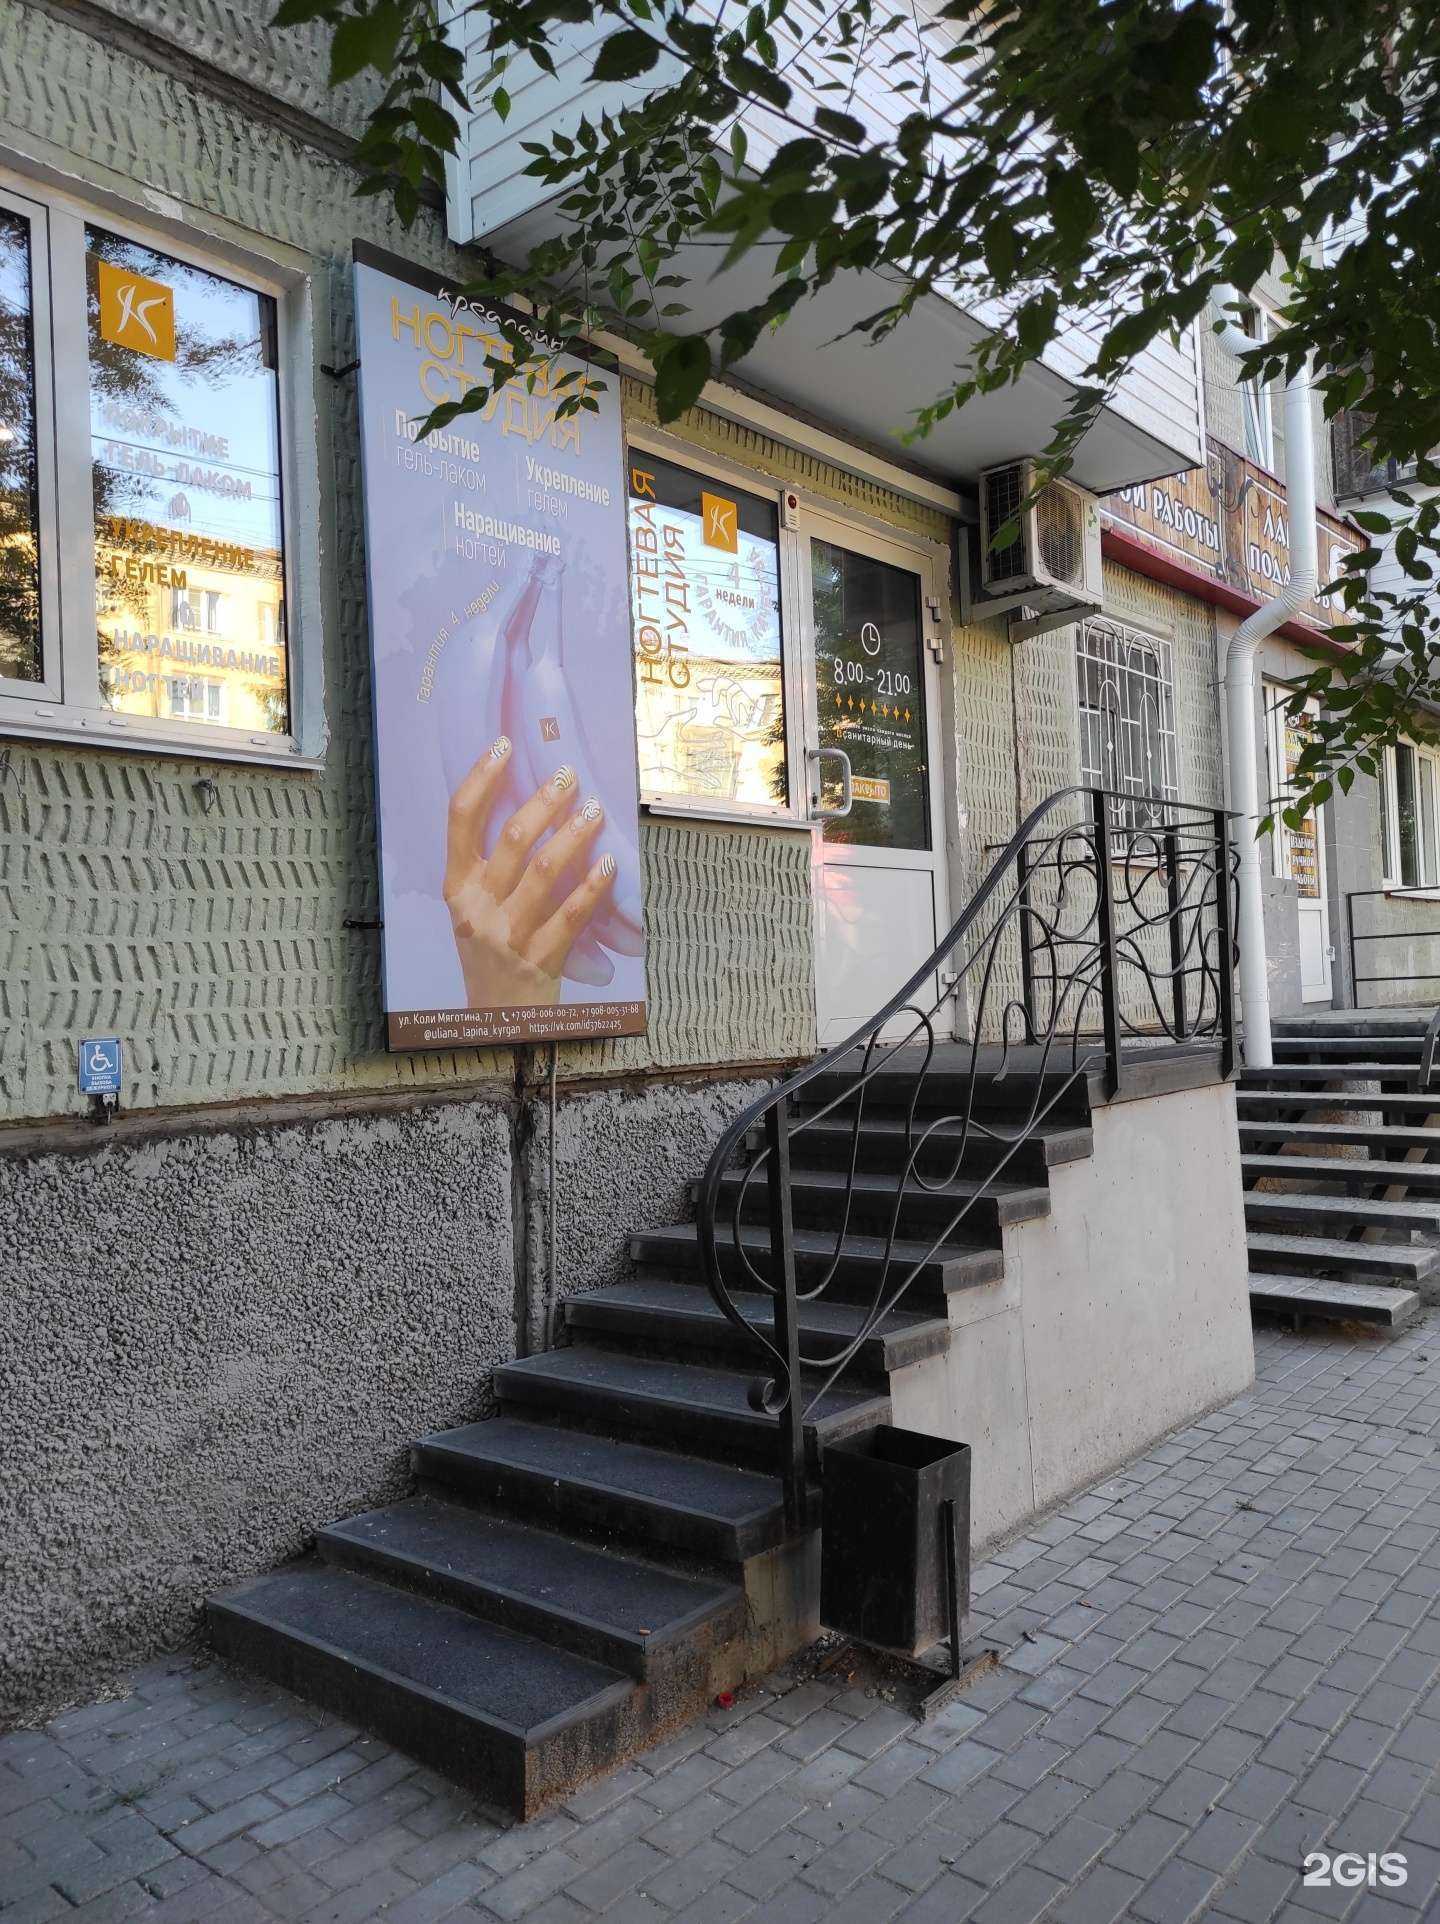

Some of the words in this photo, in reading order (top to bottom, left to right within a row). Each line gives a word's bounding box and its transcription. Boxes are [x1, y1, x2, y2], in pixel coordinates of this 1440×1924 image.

[103, 404, 230, 459] ПОКРЫТИЕ
[104, 443, 252, 500] ГЕЛЬ-ЛАКОМ
[526, 456, 611, 506] Укрепление
[528, 489, 569, 519] гелем
[1152, 487, 1220, 552] РАБОТЫ
[111, 518, 254, 569] УКРЕПЛЕНИЕ
[454, 502, 562, 555] Наращивание
[455, 537, 507, 568] ногтей
[110, 556, 187, 590] ГЕЛЕМ
[631, 467, 663, 685] НОГТЕВАЯ
[727, 562, 740, 589] 4
[663, 524, 692, 689] СТУДИЯ
[715, 588, 756, 609] недели
[114, 629, 280, 677] НАРАЩИВАНИЕ
[417, 627, 449, 705] Гарантия
[449, 608, 461, 625] 4
[463, 580, 501, 617] недели
[114, 667, 205, 699] НОГТЕЙ
[842, 729, 892, 747] санитарный
[893, 738, 912, 750] день
[398, 1016, 412, 1028] ул.
[413, 1012, 436, 1025] Коли
[437, 1012, 483, 1024] Мяготина,
[483, 1012, 494, 1023] 77
[511, 1011, 520, 1021] +7
[423, 1023, 521, 1041] @uliana_lapina_kyrgan
